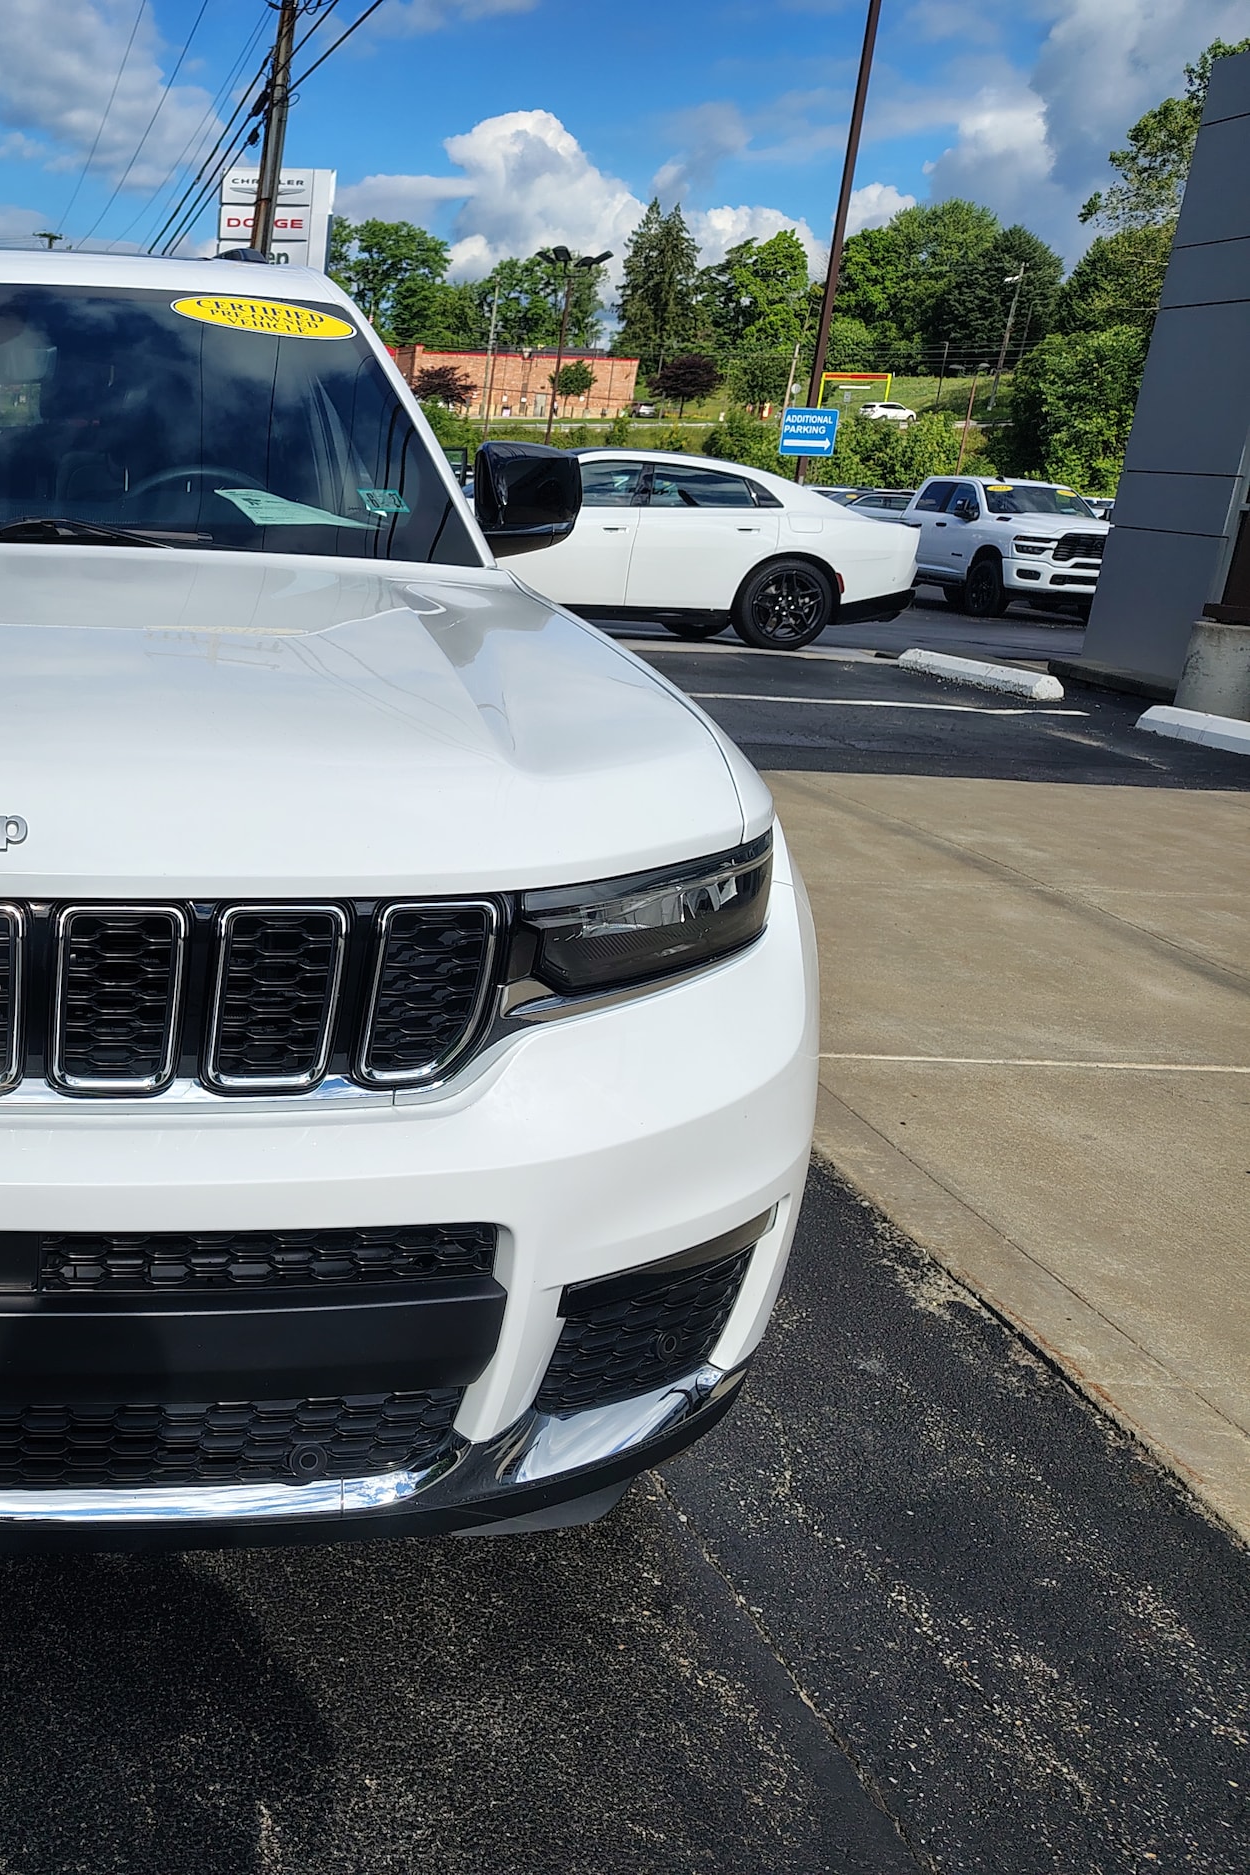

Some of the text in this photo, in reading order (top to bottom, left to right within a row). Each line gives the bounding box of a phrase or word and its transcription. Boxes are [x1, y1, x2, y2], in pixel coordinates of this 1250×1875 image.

[231, 178, 305, 186] CHRLER
[226, 218, 303, 229] DOGE
[196, 299, 324, 323] CERTIFIED
[210, 309, 319, 329] PRE-OWNED
[227, 317, 309, 334] VEHICLE
[785, 414, 833, 424] ADDITIONAL
[783, 425, 826, 434] PARKING
